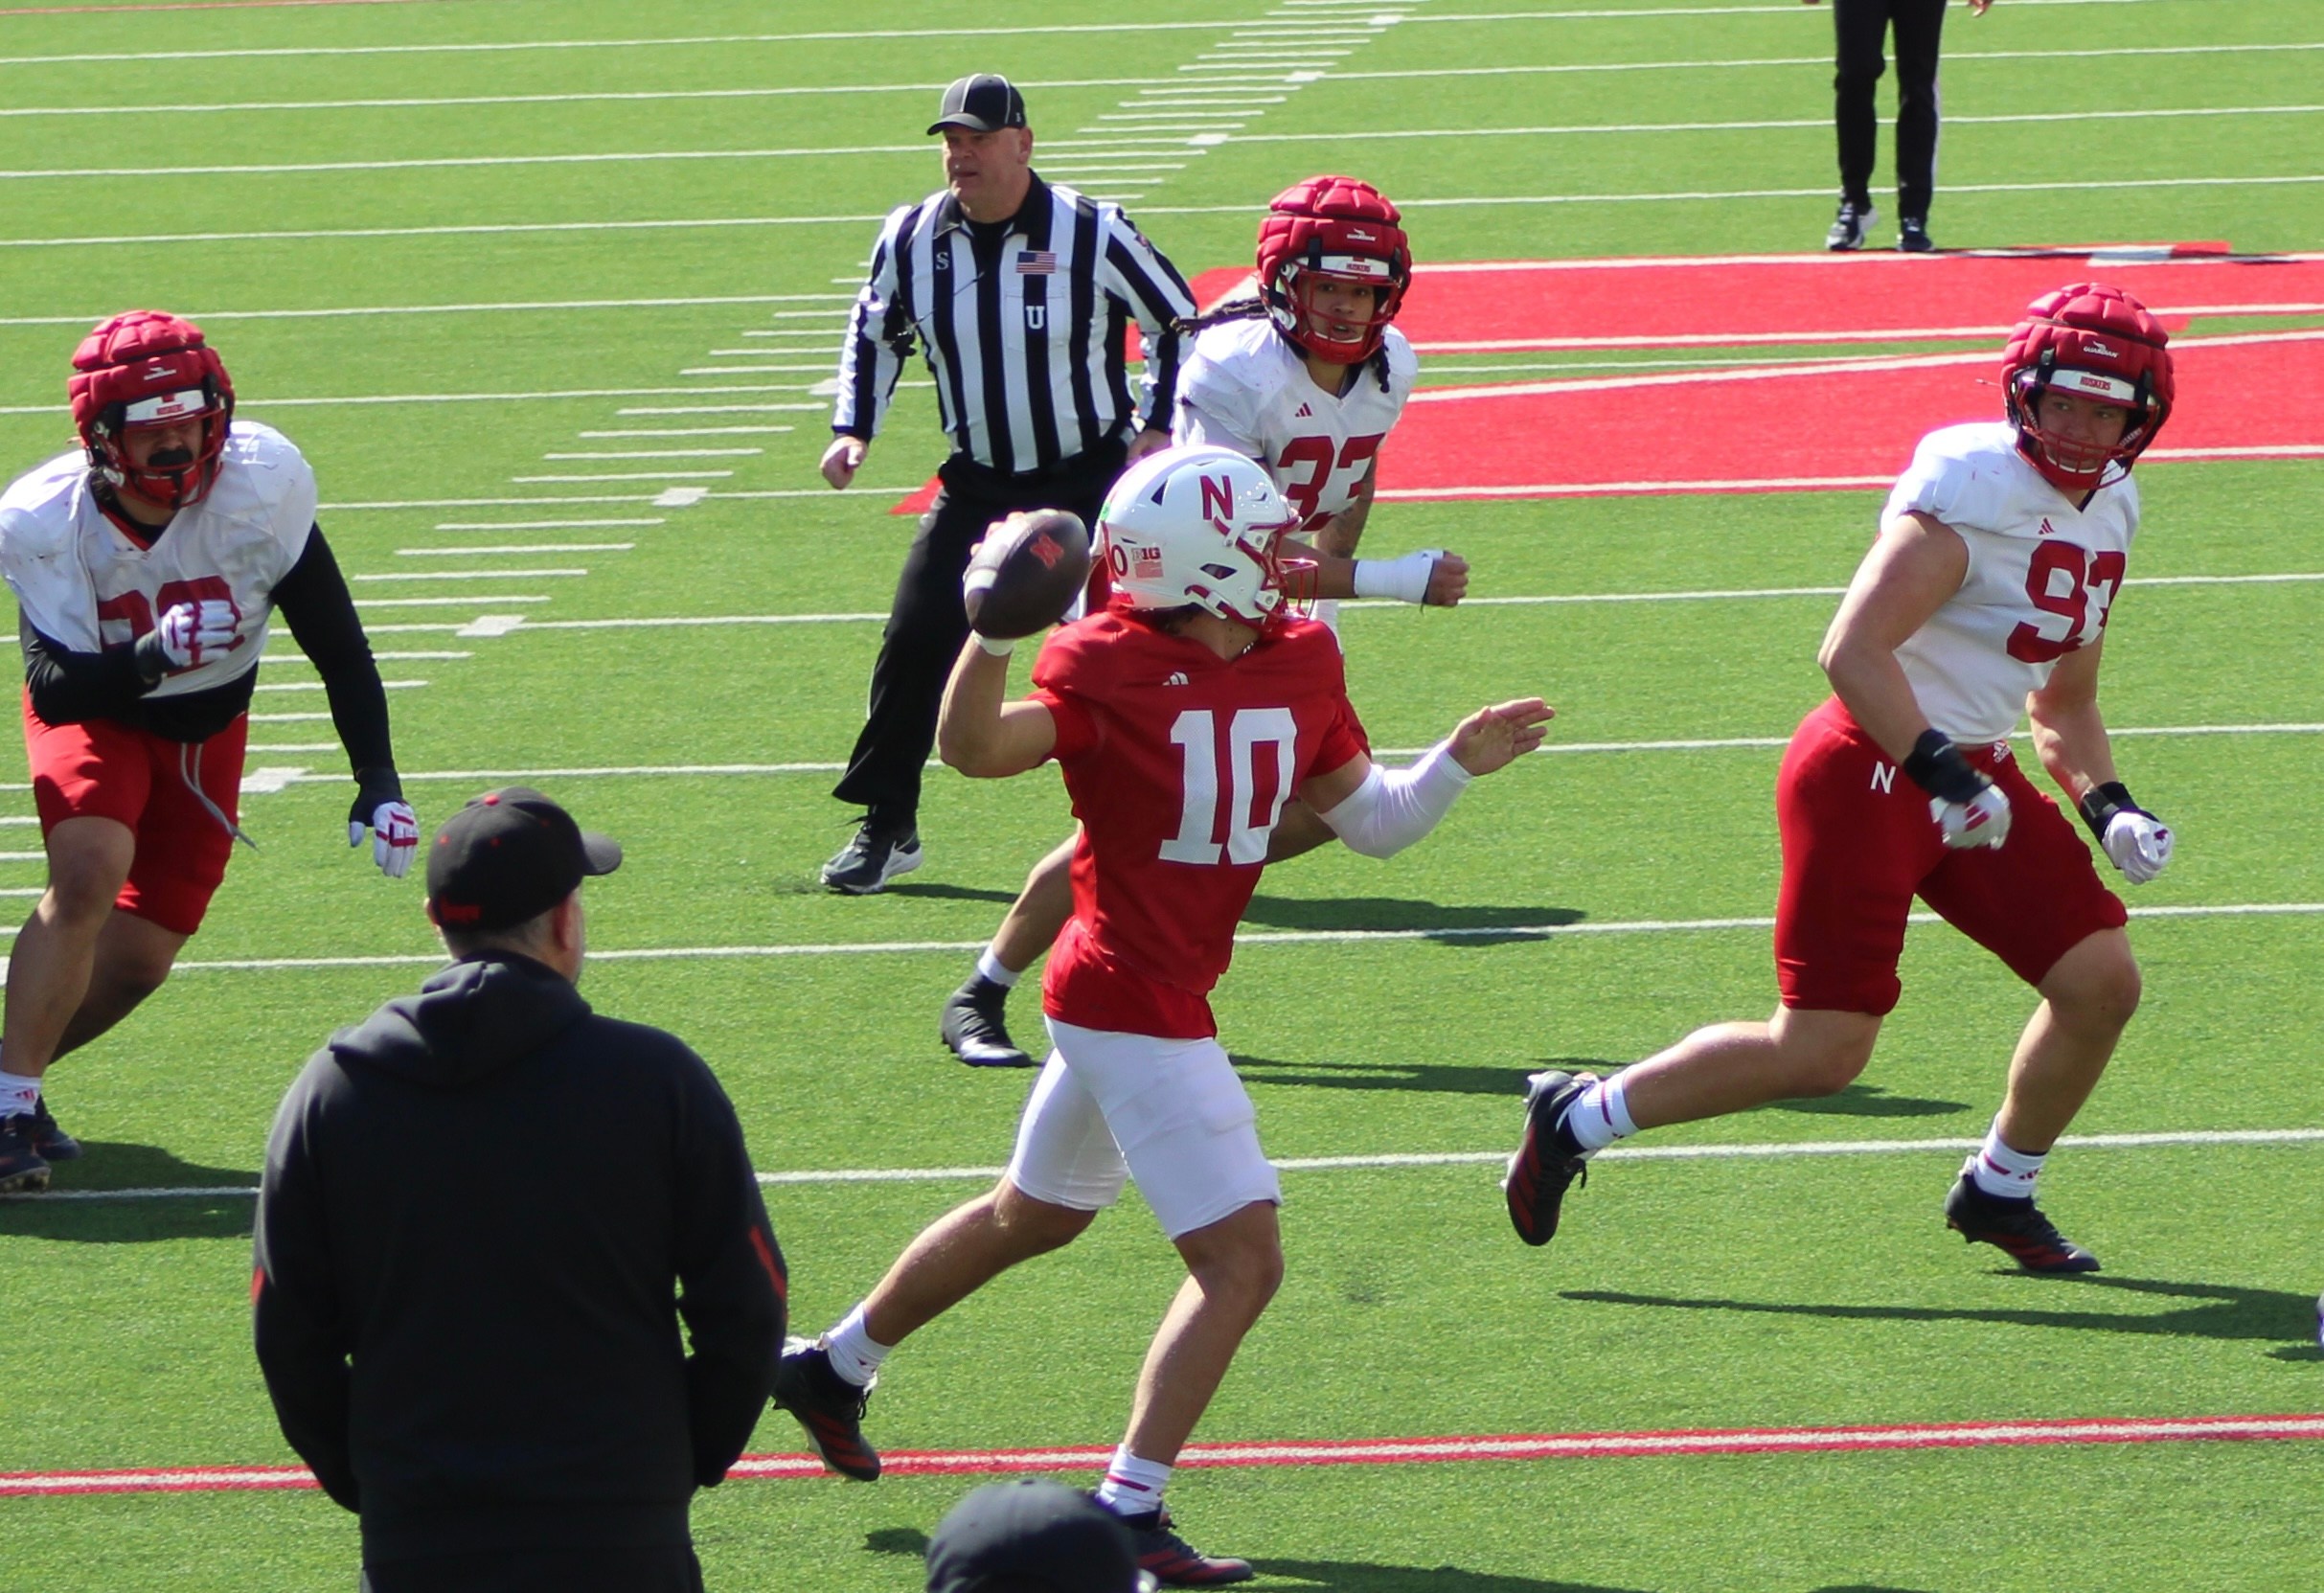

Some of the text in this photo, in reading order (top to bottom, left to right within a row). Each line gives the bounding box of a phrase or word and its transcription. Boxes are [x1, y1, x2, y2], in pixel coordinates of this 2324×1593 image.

[936, 252, 949, 270] S
[1026, 306, 1045, 330] U
[1199, 474, 1234, 520] N
[1158, 707, 1298, 864] 10
[1870, 761, 1896, 794] N
